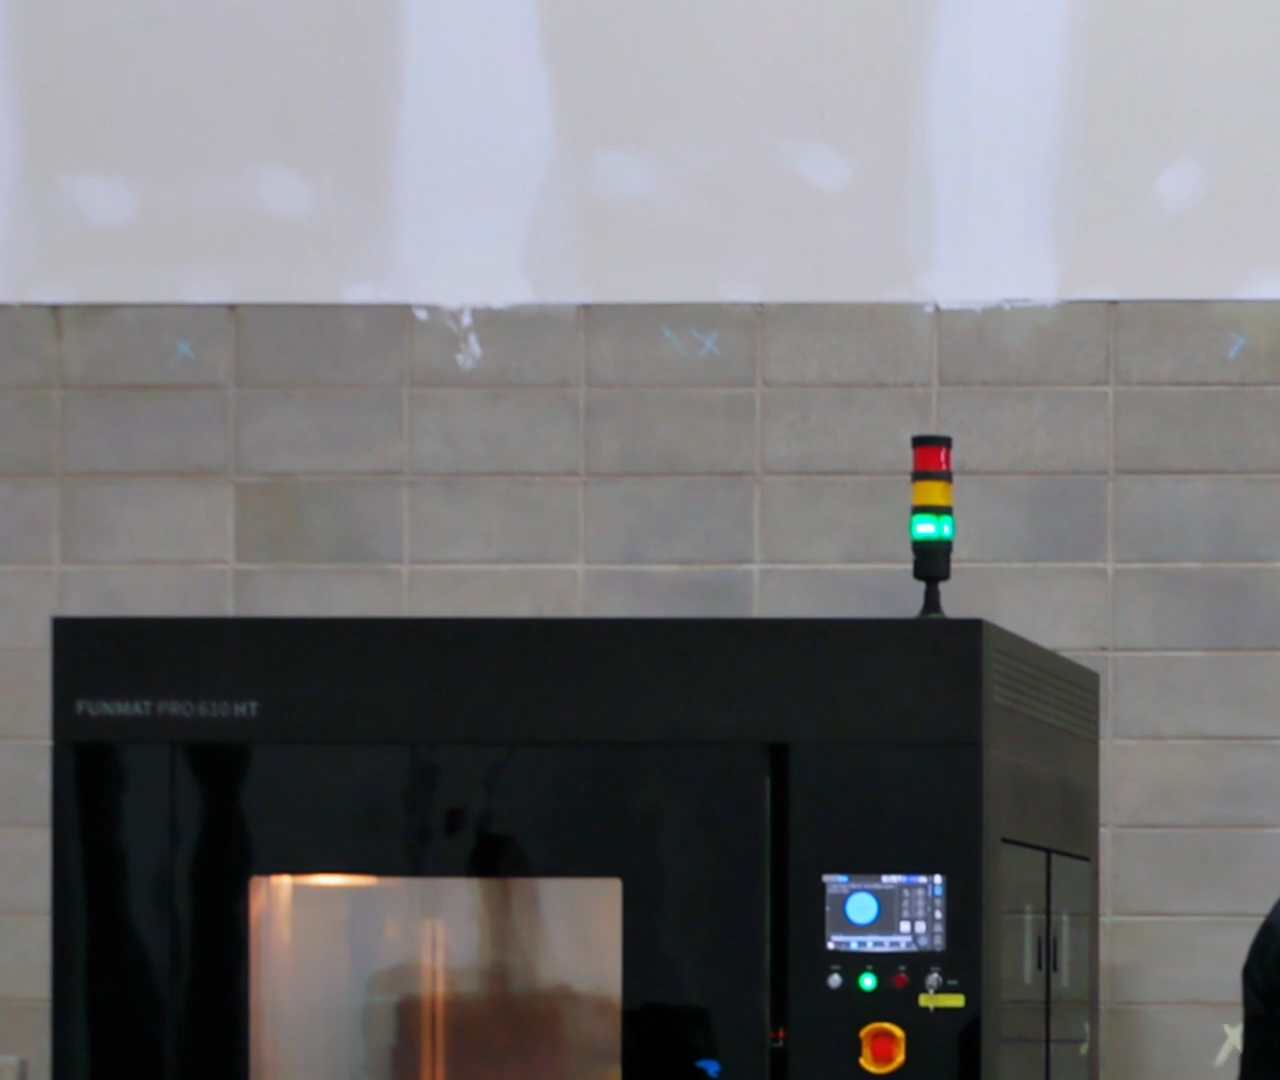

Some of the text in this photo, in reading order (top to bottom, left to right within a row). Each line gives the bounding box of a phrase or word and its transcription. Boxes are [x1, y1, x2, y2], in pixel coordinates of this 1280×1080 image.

[75, 700, 152, 717] FUNMAT
[156, 701, 194, 717] PRO
[234, 702, 259, 717] HT
